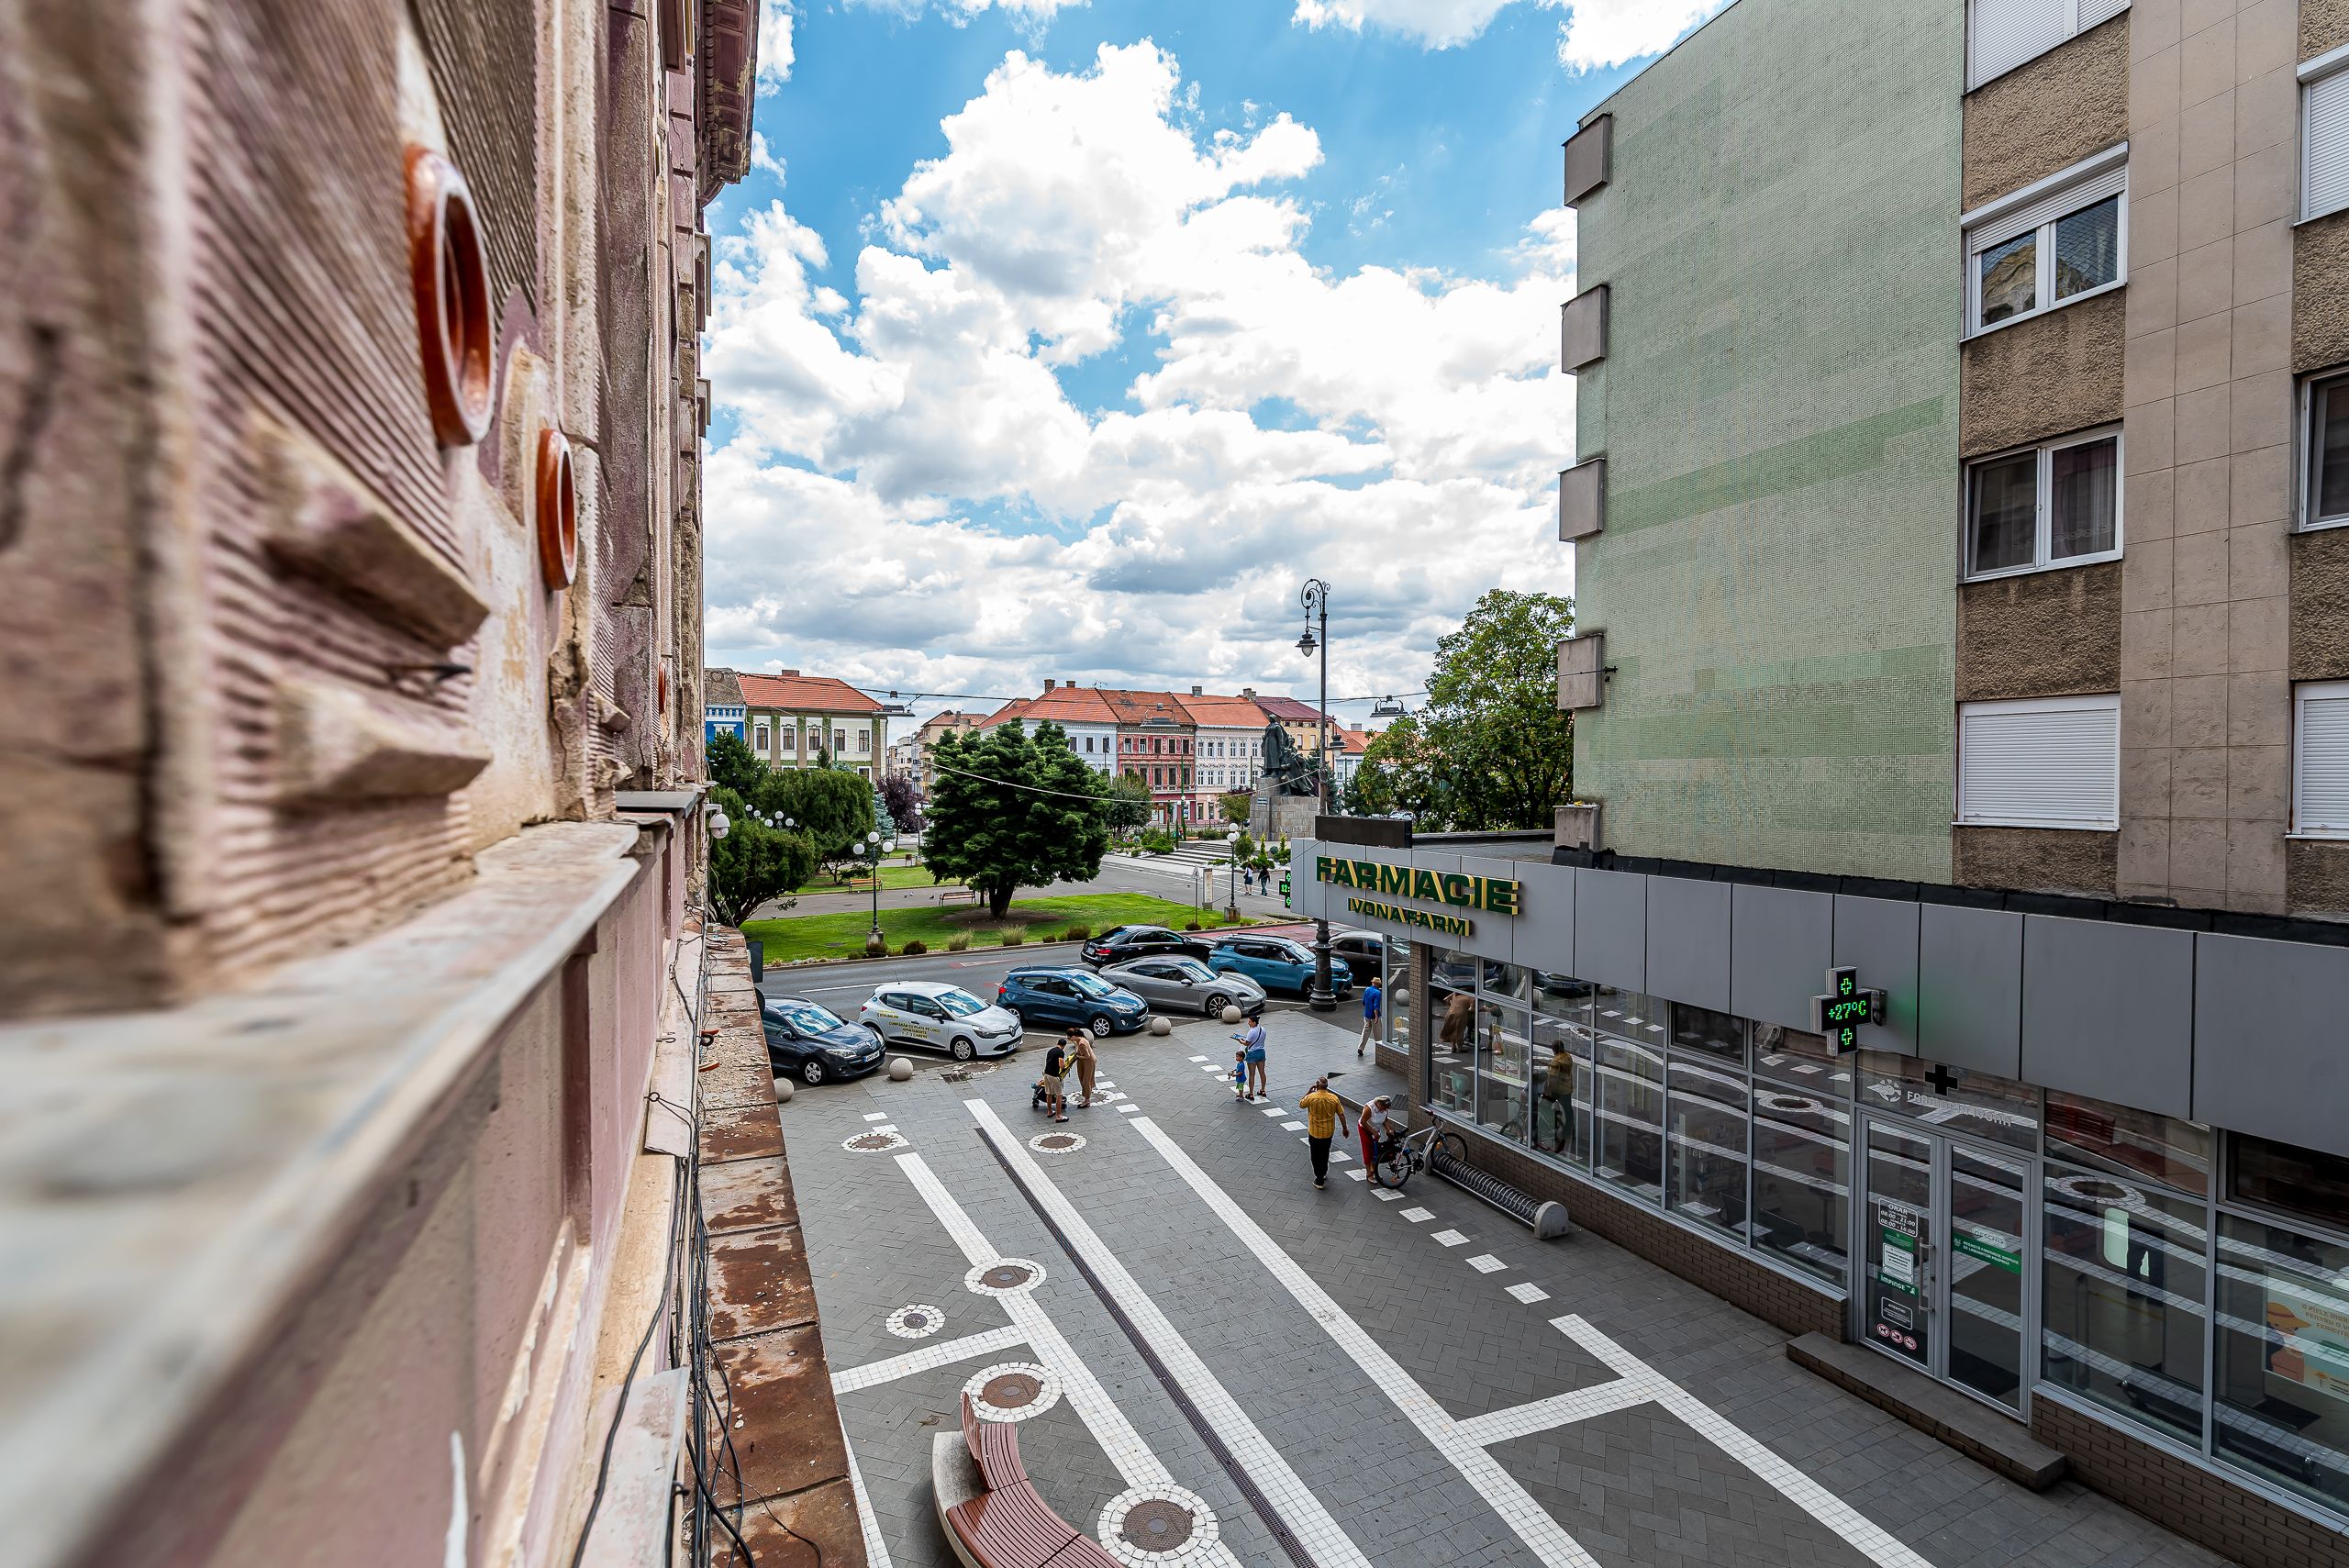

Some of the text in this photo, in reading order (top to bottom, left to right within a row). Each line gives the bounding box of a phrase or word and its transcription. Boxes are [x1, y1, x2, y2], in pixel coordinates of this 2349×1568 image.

[1281, 884, 1290, 893] 12:
[1316, 855, 1519, 915] FARMACIE
[1828, 1000, 1866, 1020] +27°C
[1888, 1204, 1908, 1215] ORAR
[1880, 1210, 1897, 1219] 08:00
[1899, 1218, 1916, 1227] 21:00
[1880, 1218, 1897, 1228] 08:00
[1974, 1230, 2004, 1244] DESCHIS
